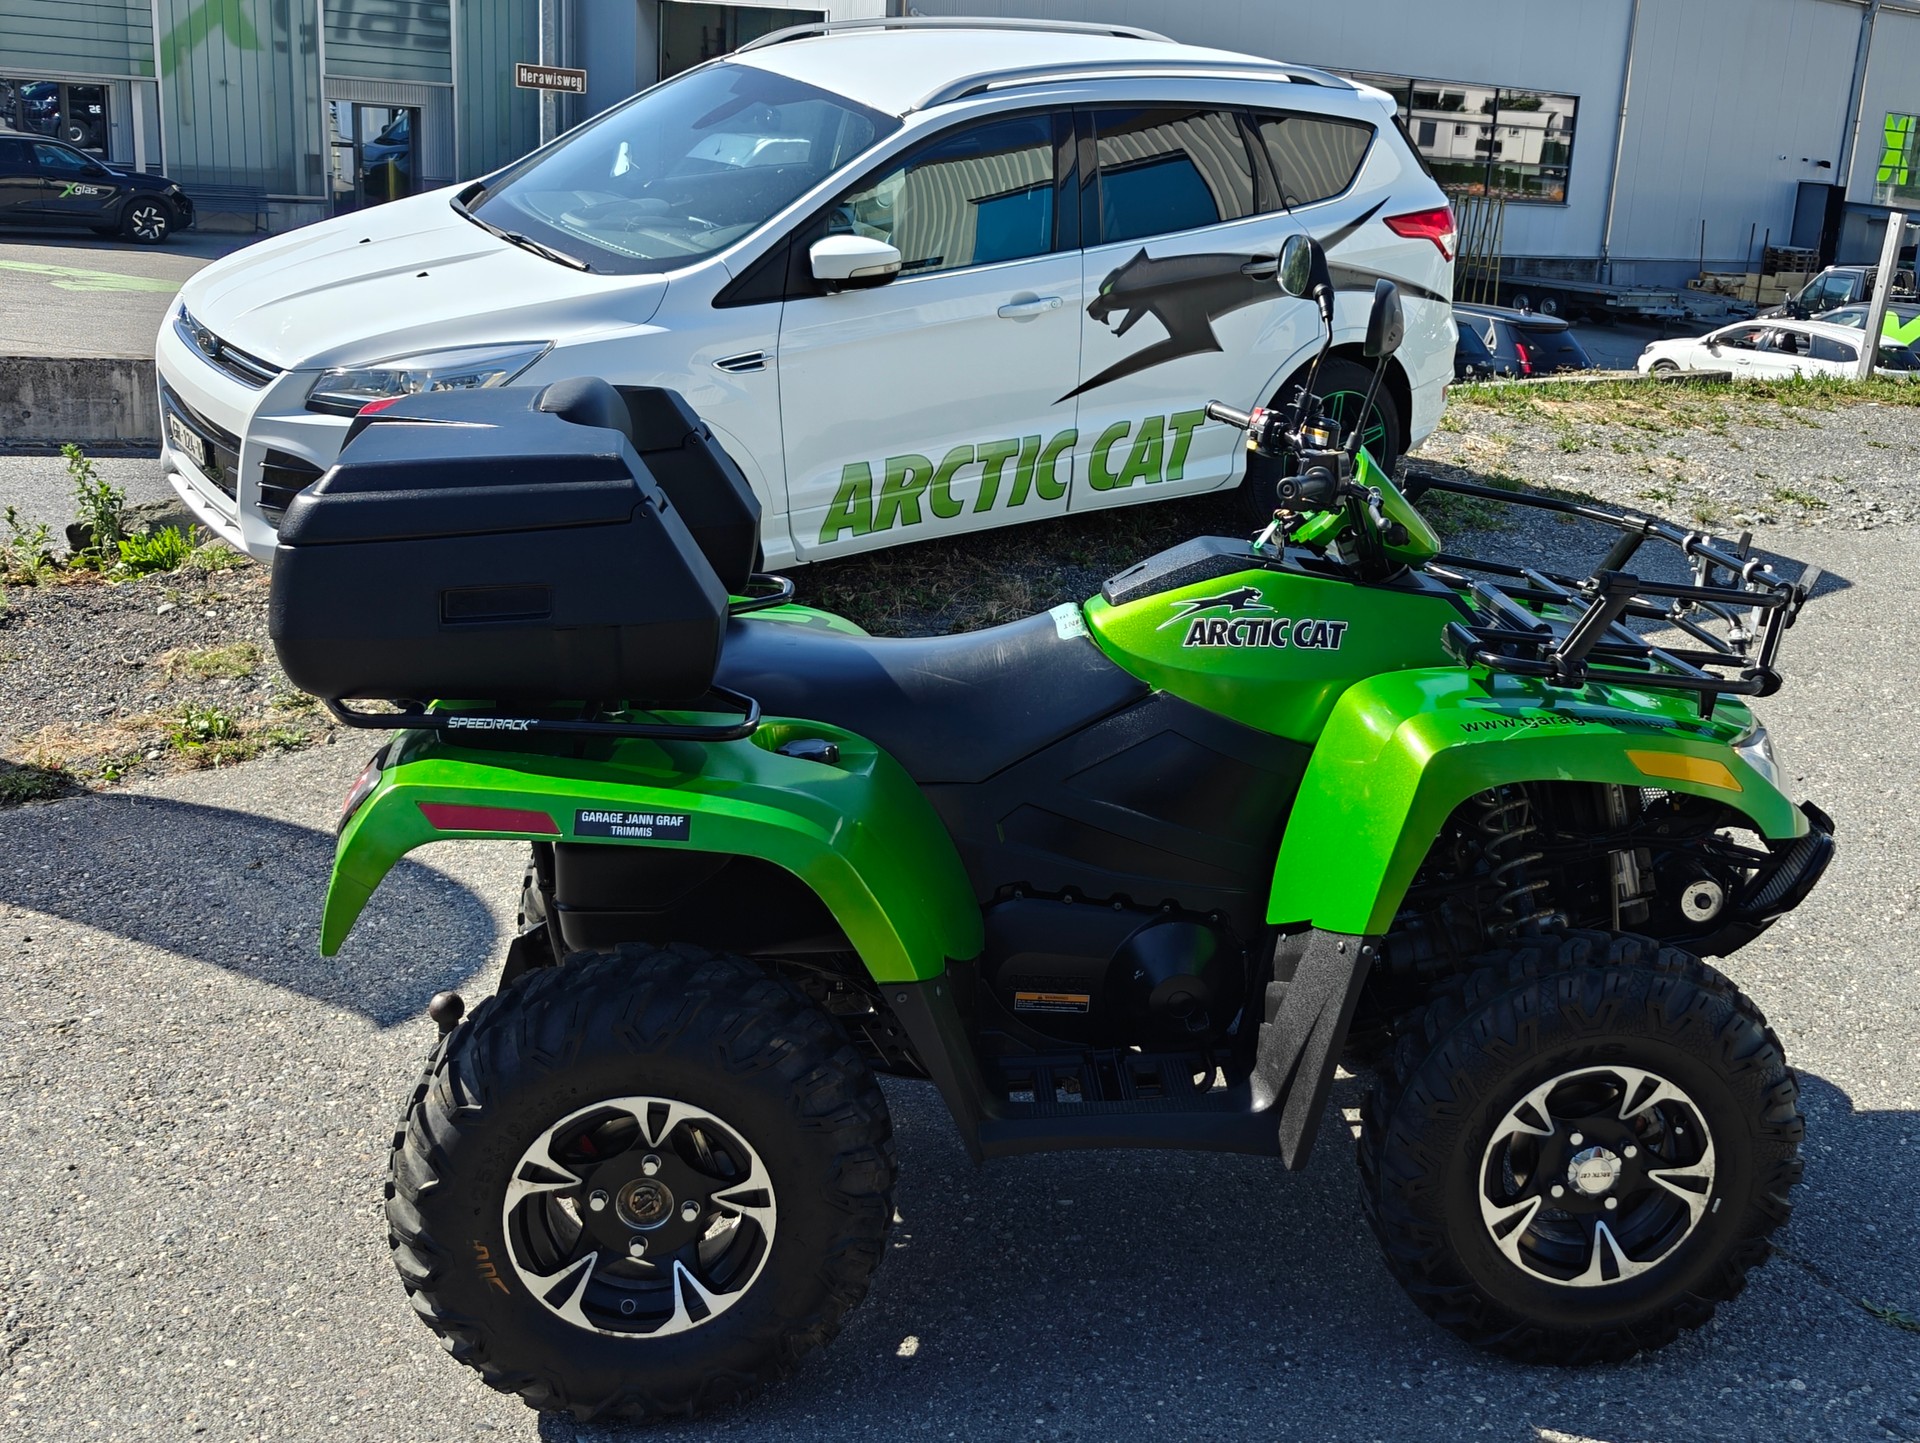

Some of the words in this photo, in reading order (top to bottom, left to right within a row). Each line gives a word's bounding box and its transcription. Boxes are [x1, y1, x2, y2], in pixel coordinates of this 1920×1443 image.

[520, 67, 583, 92] Herawisweg
[58, 182, 98, 198] Xglas
[818, 428, 1079, 544] ARCTIC
[1088, 408, 1207, 491] CAT
[1183, 617, 1291, 648] ARCTIC
[1292, 618, 1348, 650] CAT
[581, 811, 624, 824] GARAGE
[625, 813, 654, 825] JANN
[656, 815, 684, 827] GRAF
[610, 825, 653, 837] TRIMMIS
